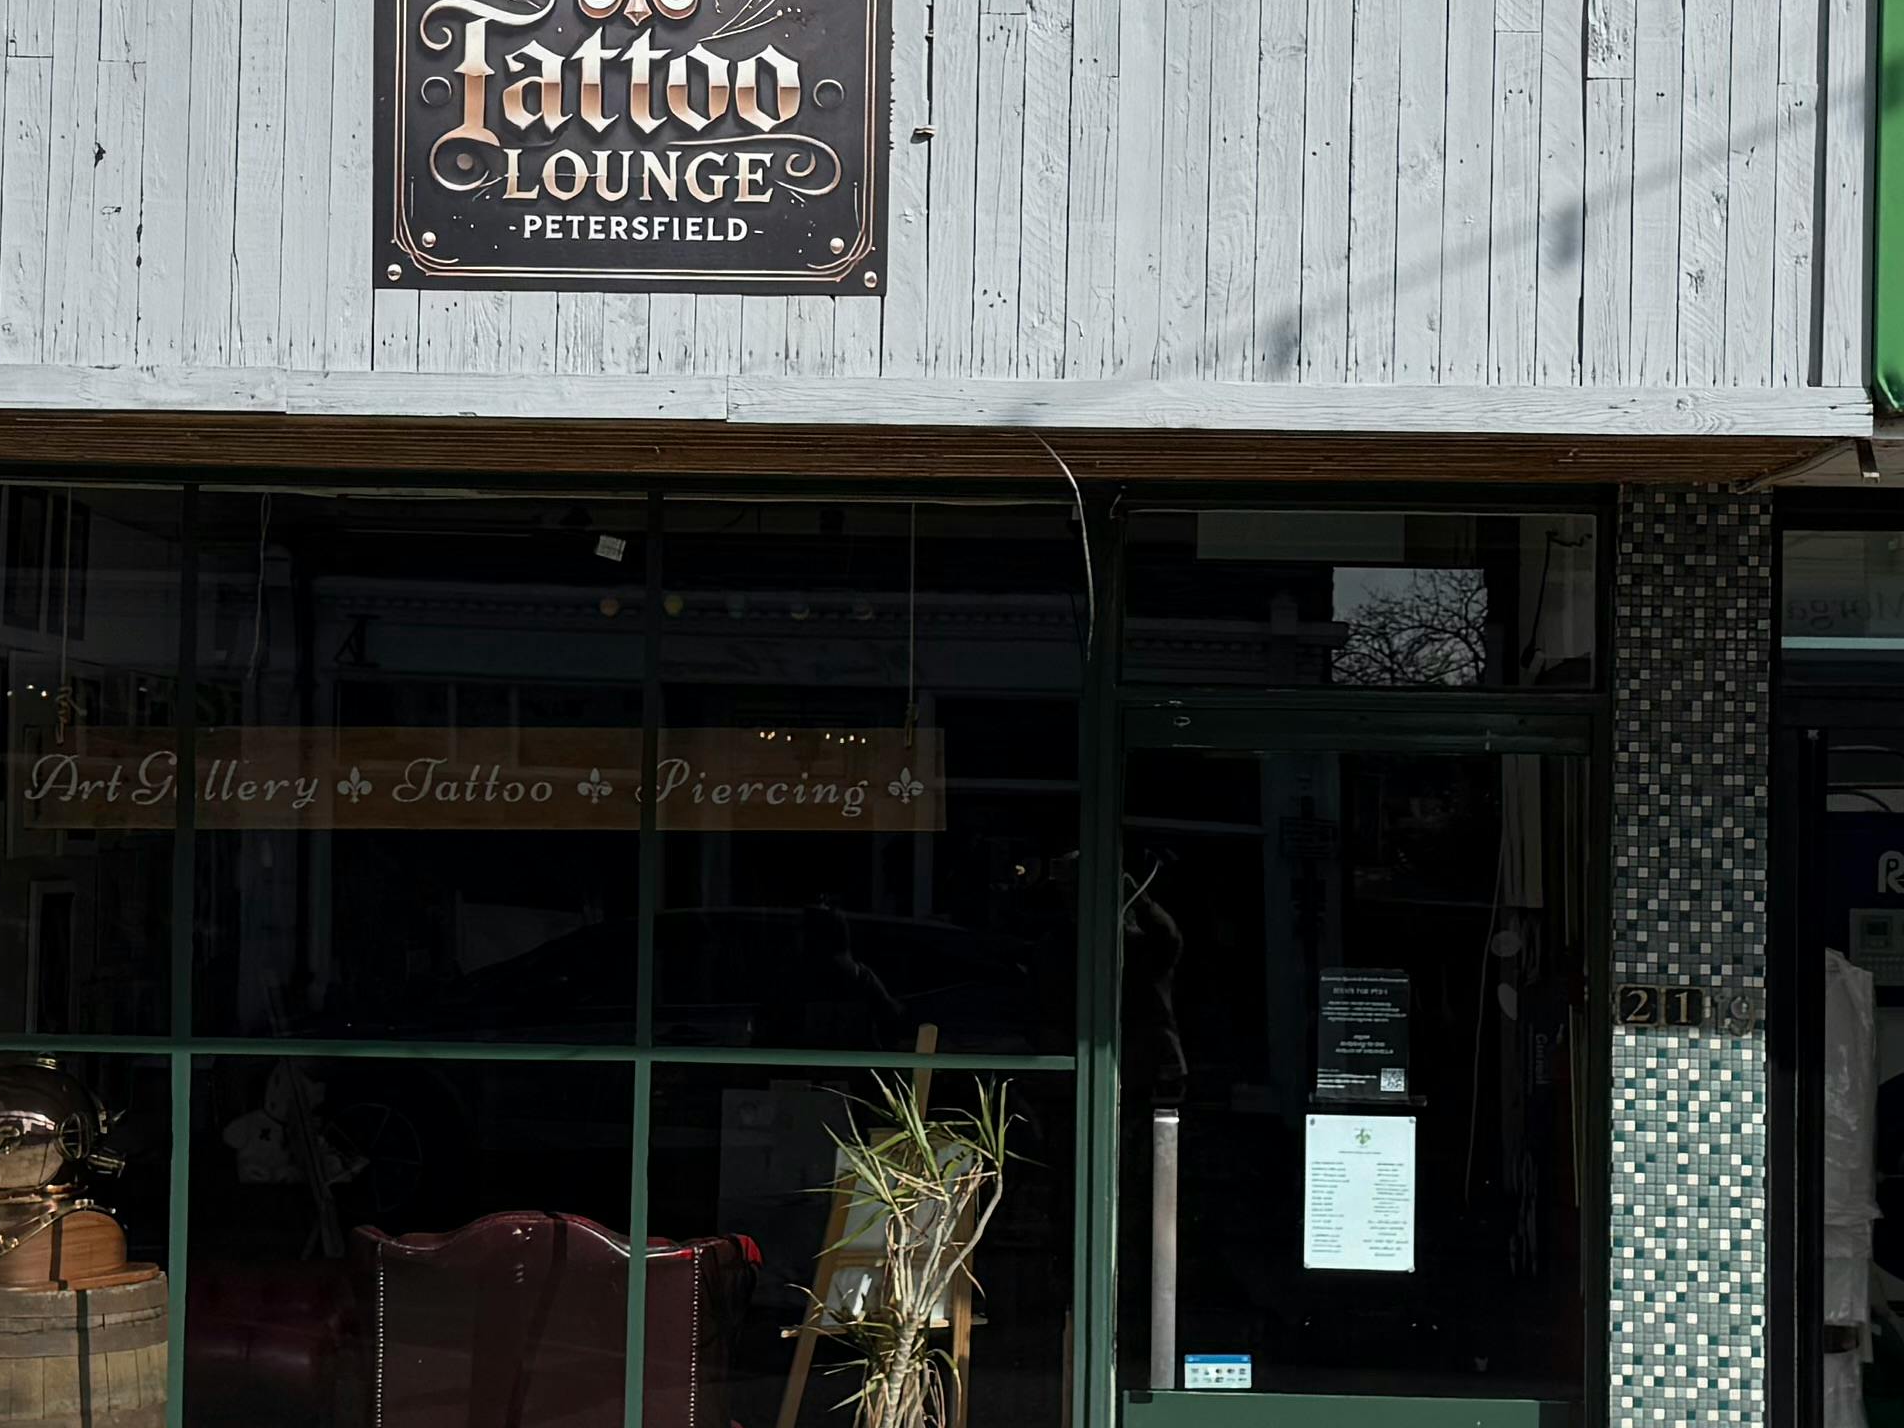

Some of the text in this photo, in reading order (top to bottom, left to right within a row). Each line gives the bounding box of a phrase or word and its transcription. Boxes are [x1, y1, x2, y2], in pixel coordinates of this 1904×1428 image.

[502, 149, 775, 204] LOUNGE
[24, 750, 867, 817] Art Gllery Tattoo Piercing
[1626, 989, 1693, 1025] 21
